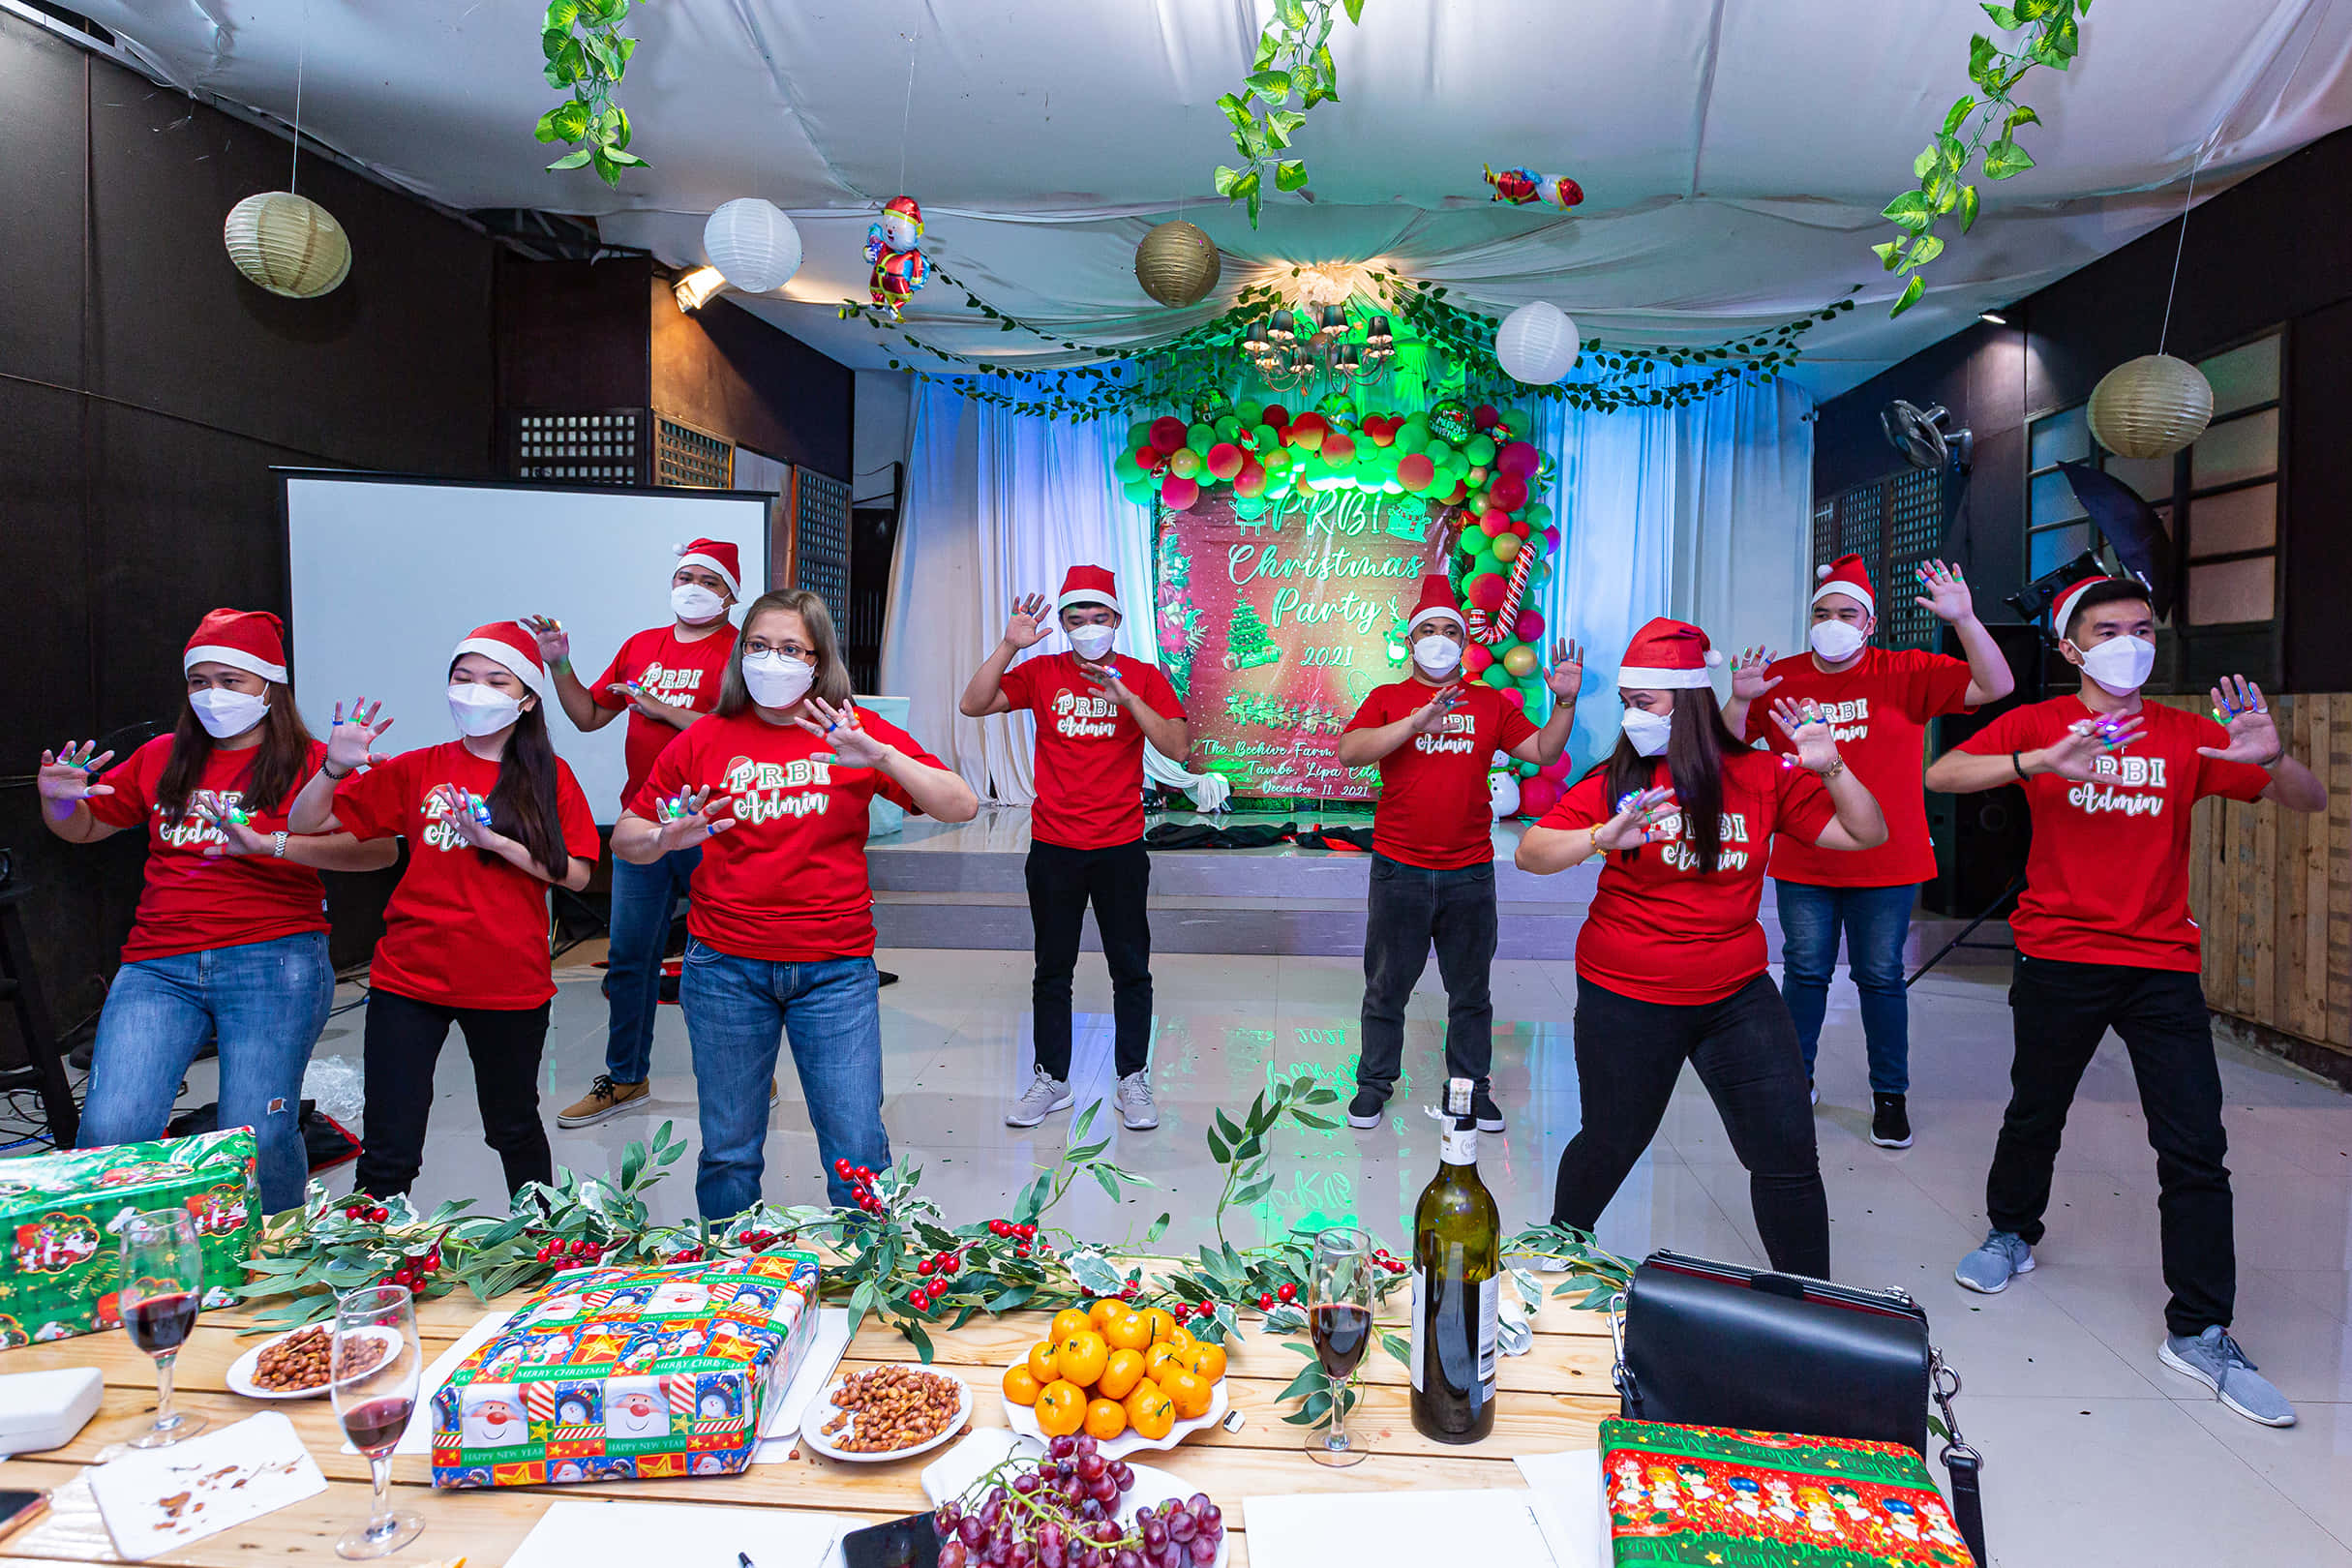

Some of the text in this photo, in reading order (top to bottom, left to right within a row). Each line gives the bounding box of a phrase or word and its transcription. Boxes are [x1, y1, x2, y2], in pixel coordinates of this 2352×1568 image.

[1228, 543, 1425, 586] Christmas
[1271, 587, 1382, 635] Party
[1300, 646, 1355, 667] 2021
[642, 669, 704, 689] PRBI
[1056, 695, 1118, 717] PRBI
[1057, 714, 1116, 738] Admin
[1202, 739, 1335, 758] The Beehive Farm
[1415, 733, 1475, 755] Admin
[729, 759, 831, 794] PRBI
[1305, 762, 1342, 781] Lipa
[1348, 765, 1380, 782] City
[2096, 755, 2167, 788] RBI
[1262, 780, 1316, 794] December
[1341, 785, 1369, 797] 2021
[733, 789, 829, 825] Admin
[2068, 782, 2163, 817] Admin
[516, 1366, 612, 1378] MERRY CHRISTMAS
[654, 1361, 689, 1371] MERRY
[464, 1447, 545, 1462] HAPPY NEW YEAR
[608, 1438, 686, 1452] HAPPY NEW YEAR
